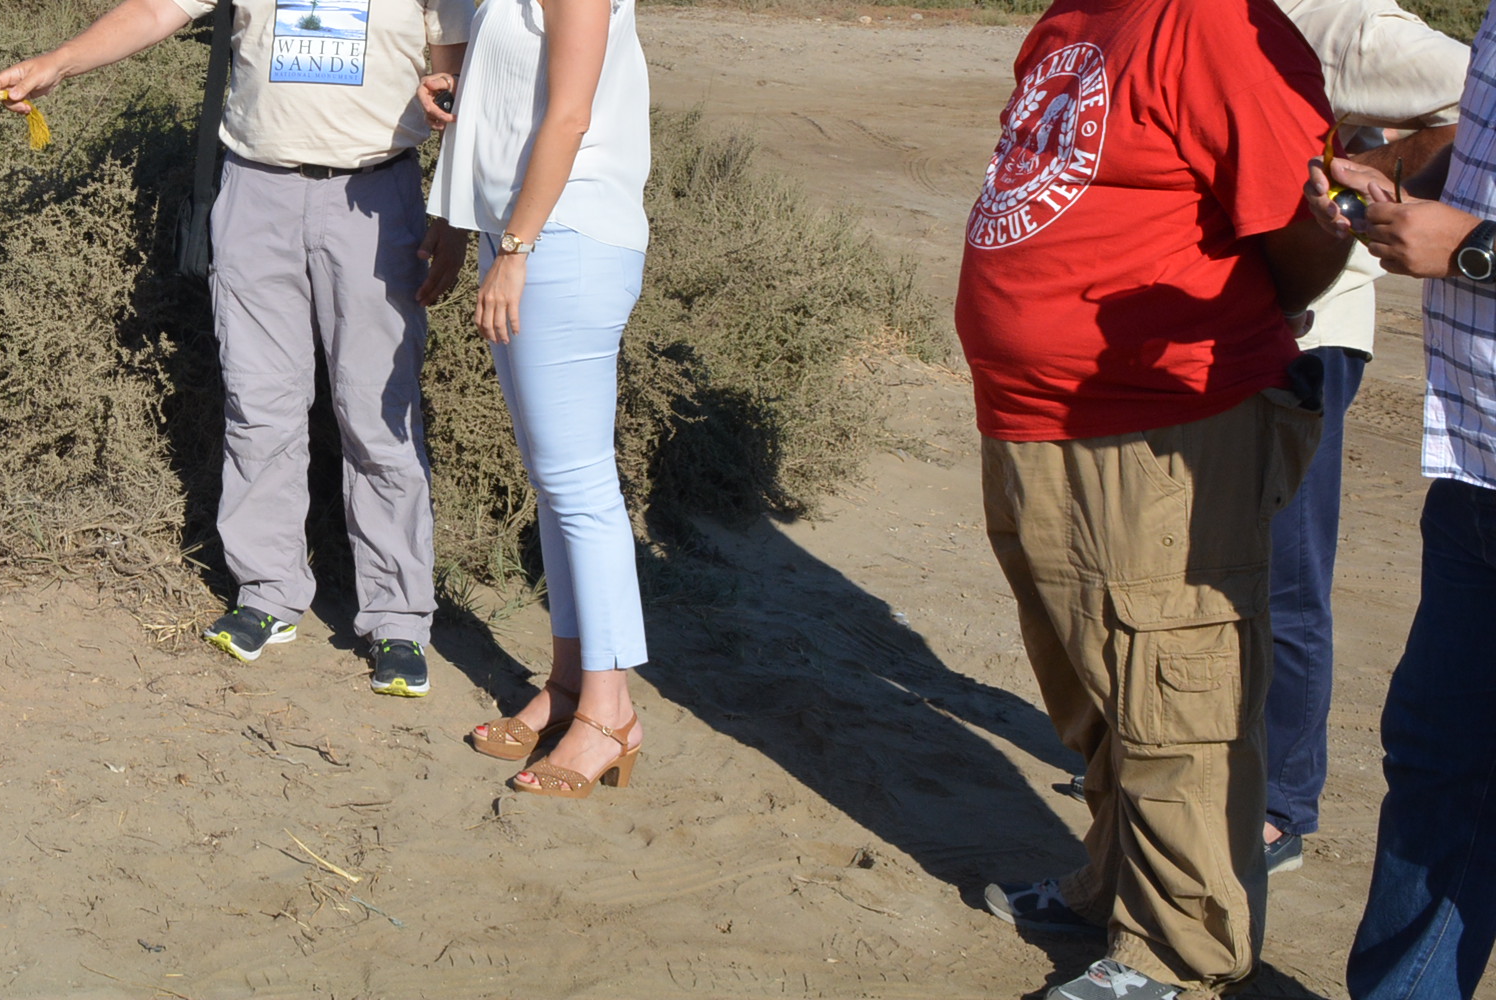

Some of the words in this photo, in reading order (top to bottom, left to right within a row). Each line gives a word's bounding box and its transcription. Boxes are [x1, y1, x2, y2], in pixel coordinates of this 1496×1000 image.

[274, 55, 360, 74] SANDS
[278, 38, 361, 57] WHITE
[1023, 47, 1093, 93] PLATO'S
[1081, 57, 1104, 112] CAVE
[970, 205, 1038, 246] RESCUE
[1037, 149, 1097, 213] TEAM
